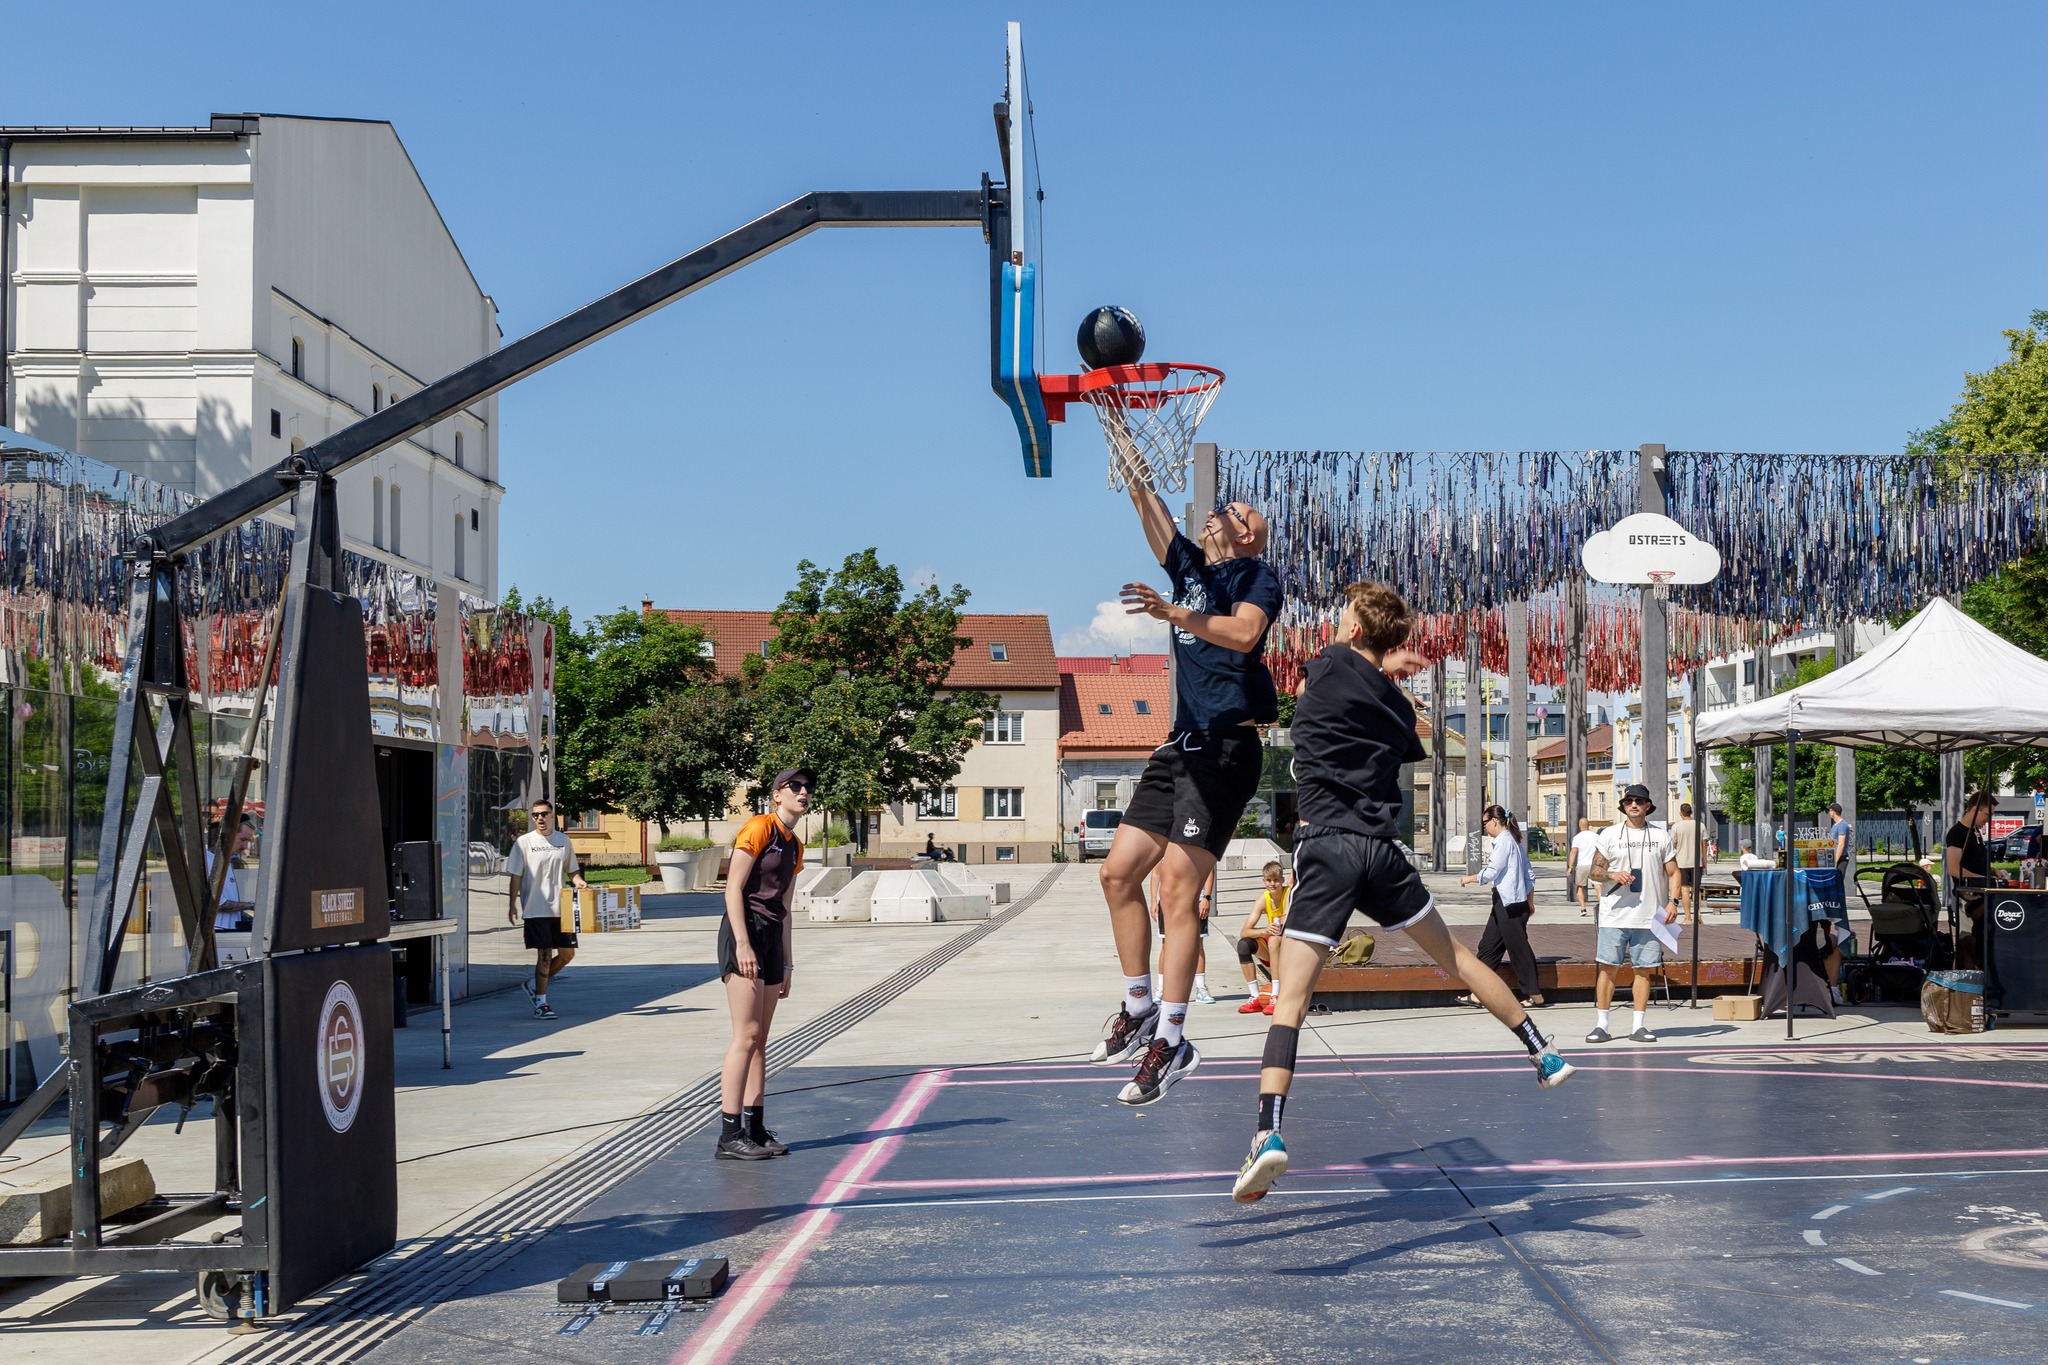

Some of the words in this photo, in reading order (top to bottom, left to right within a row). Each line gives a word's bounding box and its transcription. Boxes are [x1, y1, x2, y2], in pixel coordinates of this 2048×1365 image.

[1797, 826, 1828, 836] VICHY
[321, 893, 338, 912] BLACK
[337, 892, 355, 911] STREET
[324, 911, 353, 923] BASKETBALL
